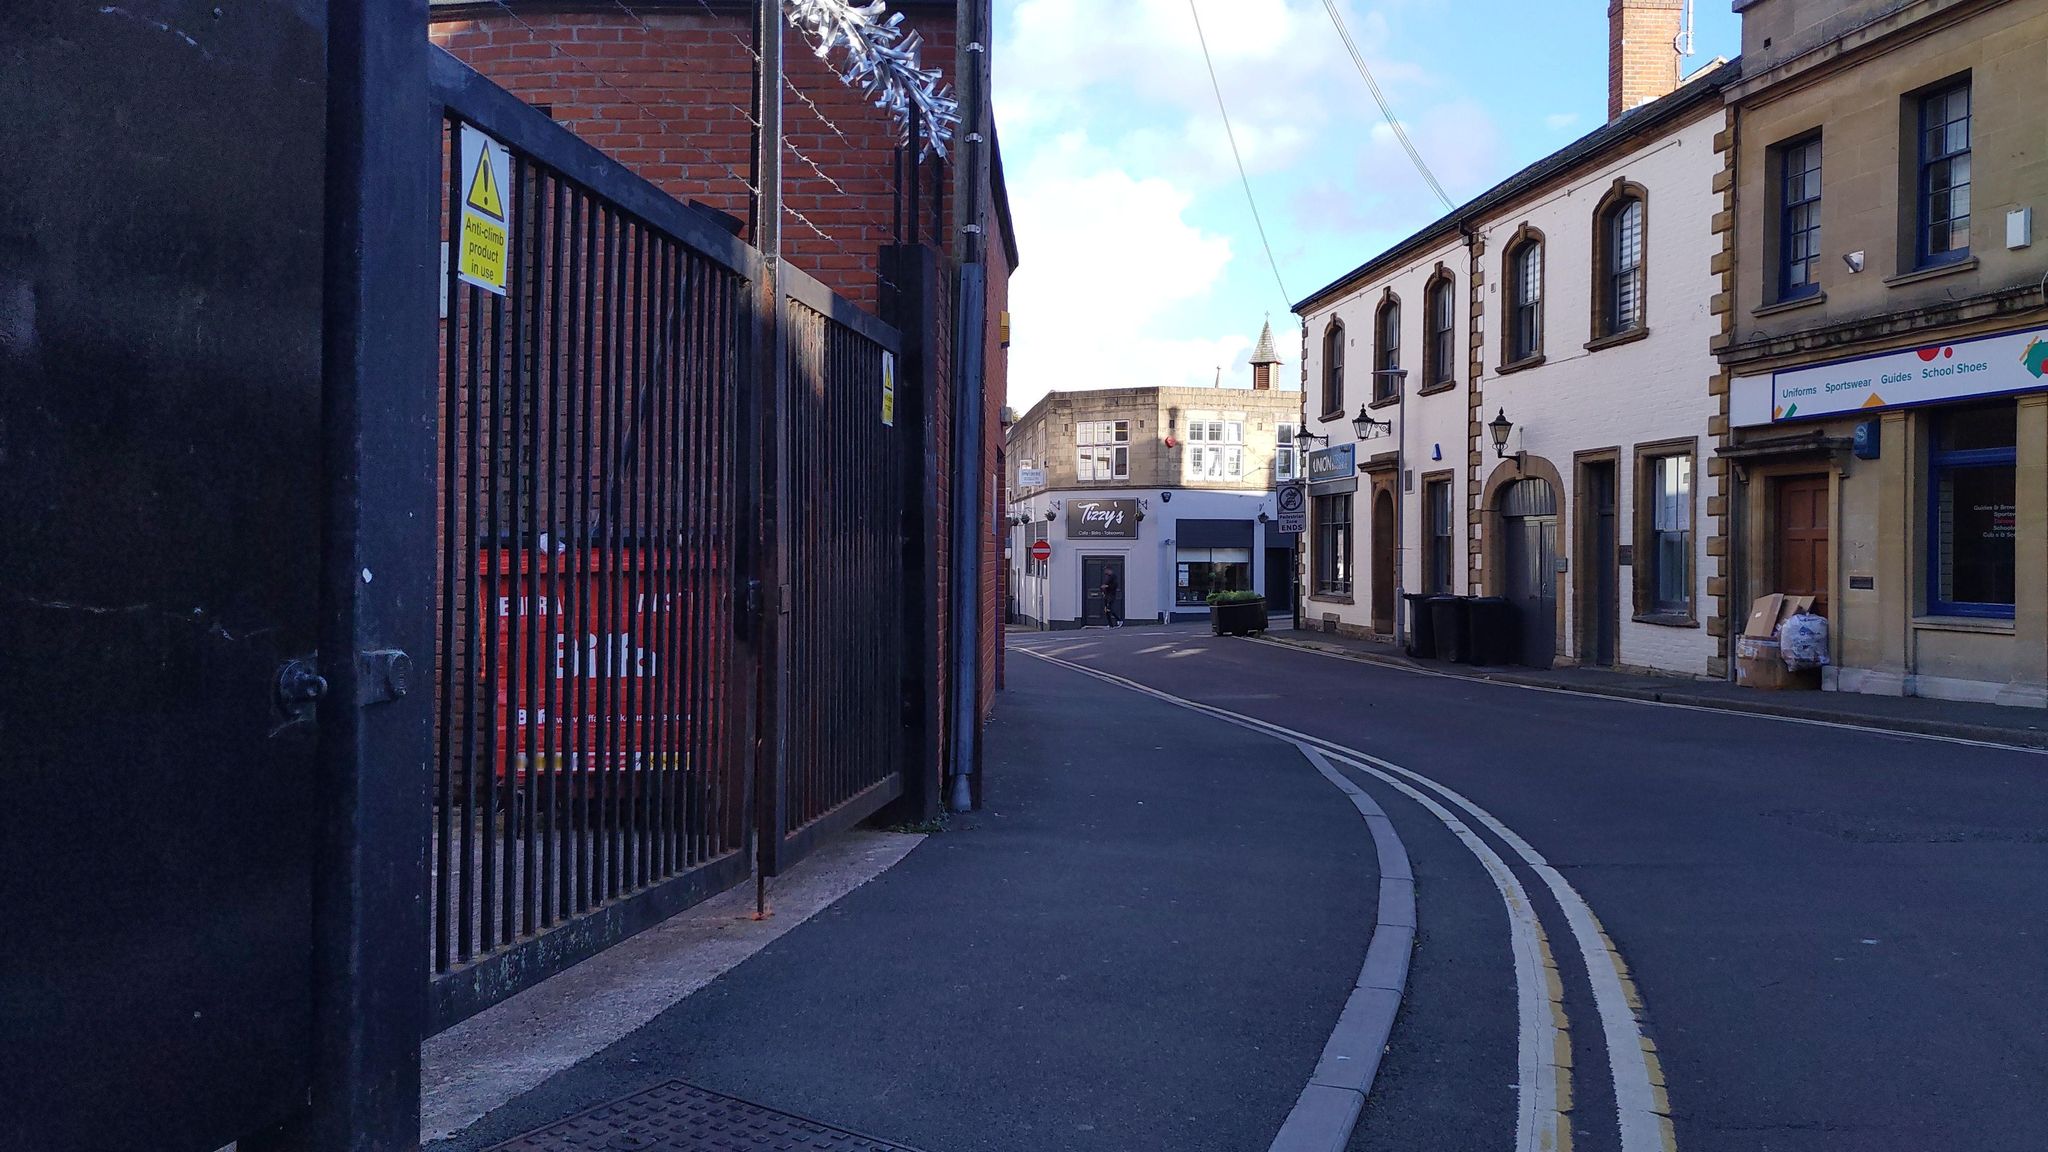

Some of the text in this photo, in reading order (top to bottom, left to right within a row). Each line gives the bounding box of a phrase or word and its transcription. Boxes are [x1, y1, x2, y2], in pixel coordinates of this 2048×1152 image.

[465, 217, 504, 246] Anti-climb
[469, 242, 499, 263] product
[471, 259, 494, 281] in use
[1782, 362, 1988, 399] Uniforms Sportswear Guides School Shoes
[1077, 501, 1125, 529] Tizzy's
